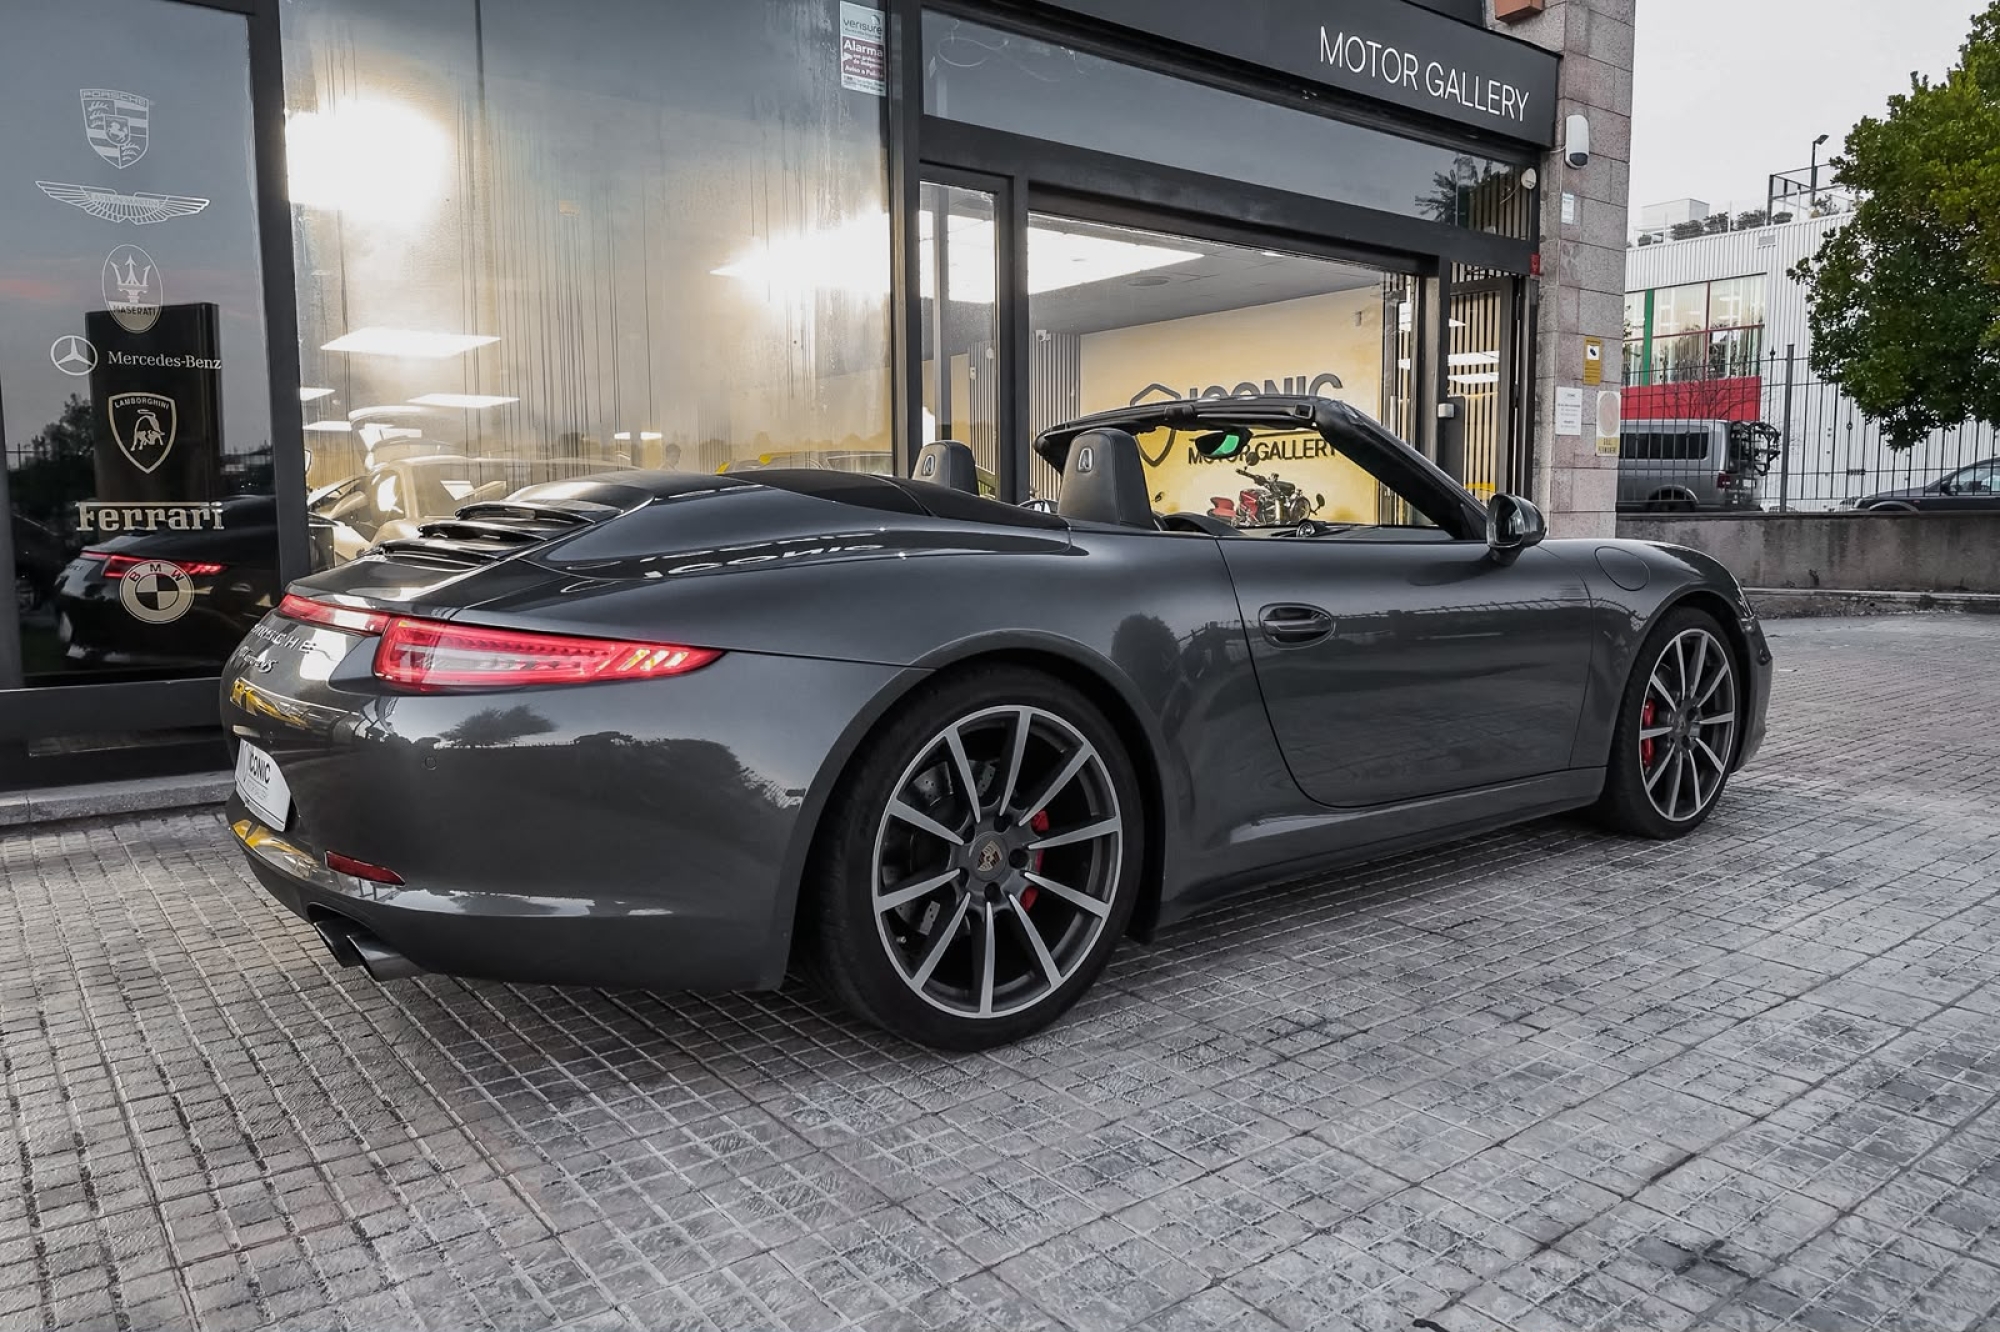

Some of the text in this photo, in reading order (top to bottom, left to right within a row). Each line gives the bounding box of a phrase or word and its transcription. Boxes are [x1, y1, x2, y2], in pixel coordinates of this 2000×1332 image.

[843, 19, 882, 34] verisure
[844, 40, 883, 57] Alarma
[1320, 26, 1530, 122] MOTOR GALLERY
[113, 304, 156, 316] MASERATI
[107, 351, 222, 369] Mercedes-Benz
[75, 501, 225, 531] Ferrari
[128, 563, 185, 583] BMW
